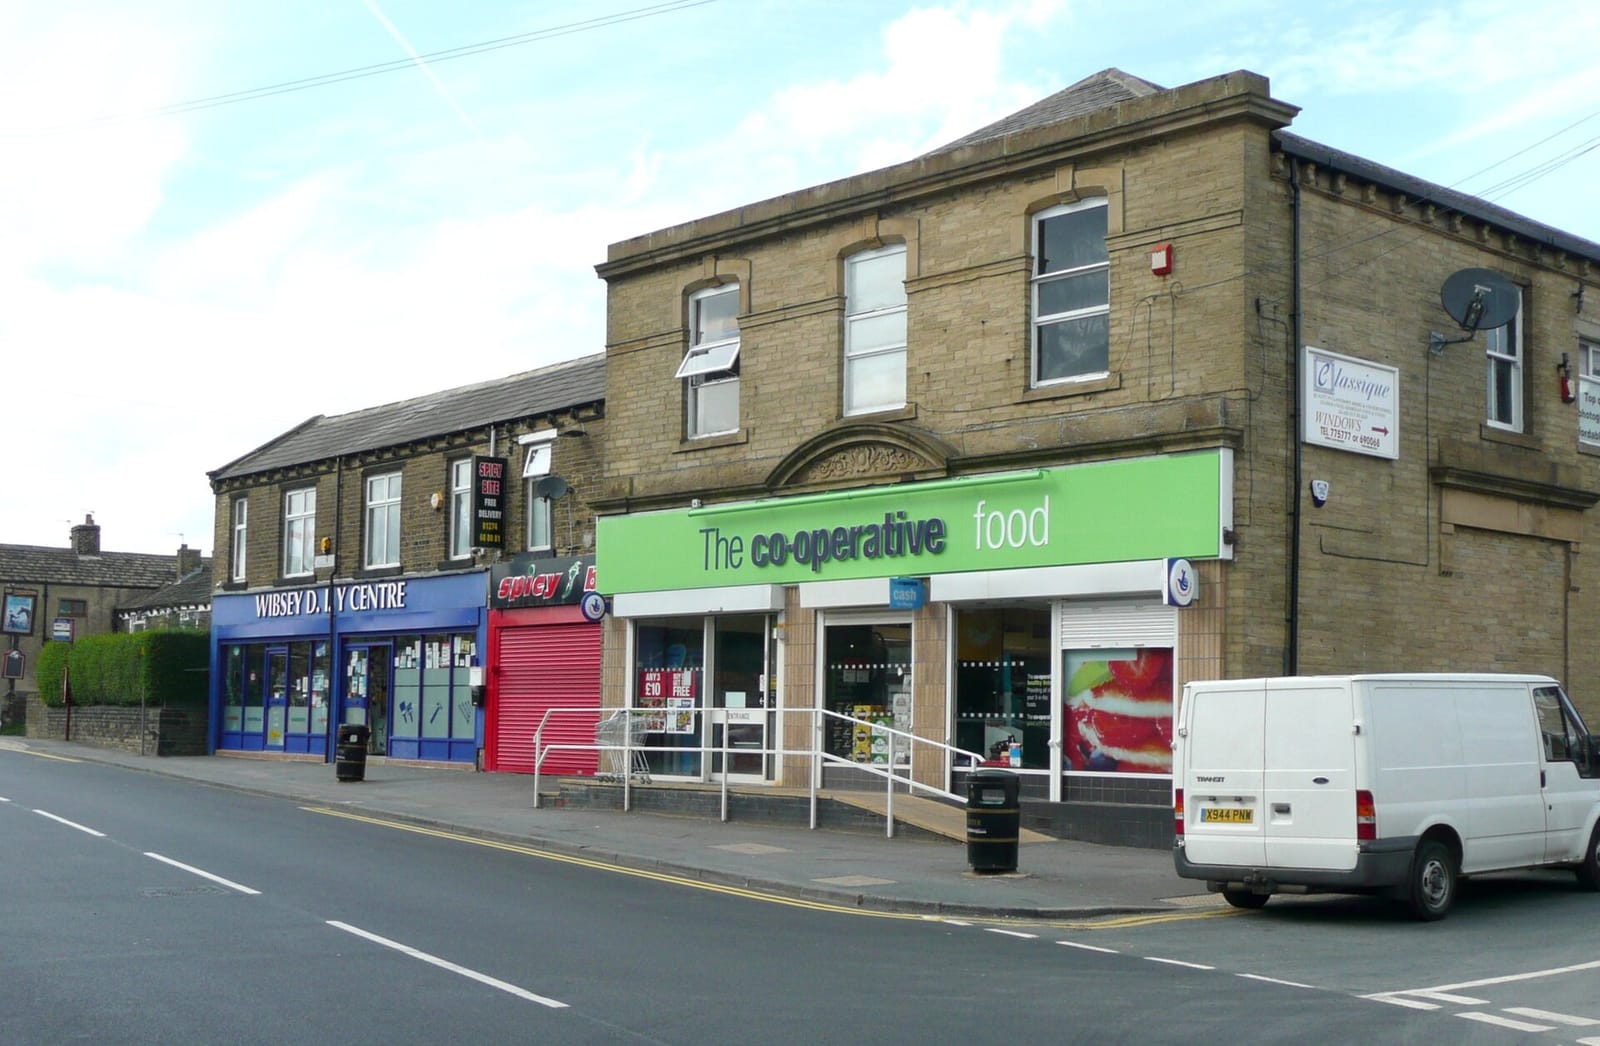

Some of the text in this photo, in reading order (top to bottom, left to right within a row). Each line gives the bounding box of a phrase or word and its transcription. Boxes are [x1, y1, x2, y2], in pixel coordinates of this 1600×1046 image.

[1317, 362, 1391, 401] Classique
[1315, 410, 1362, 432] WINDOWS
[1320, 426, 1329, 436] TEL
[479, 462, 502, 478] SPICY
[482, 480, 500, 495] BITE
[484, 498, 497, 507] FREE
[478, 509, 503, 519] DELIVERY
[700, 495, 1050, 574] The co-operative food
[498, 564, 564, 602] spicy
[255, 590, 303, 618] WIBSEY
[336, 586, 347, 612] Y
[350, 581, 406, 611] CENTRE
[893, 587, 917, 601] cash
[645, 682, 661, 697] £10
[673, 686, 691, 697] FREE
[727, 711, 750, 720] ENTRANCE
[1206, 808, 1253, 821] X944 PNW
